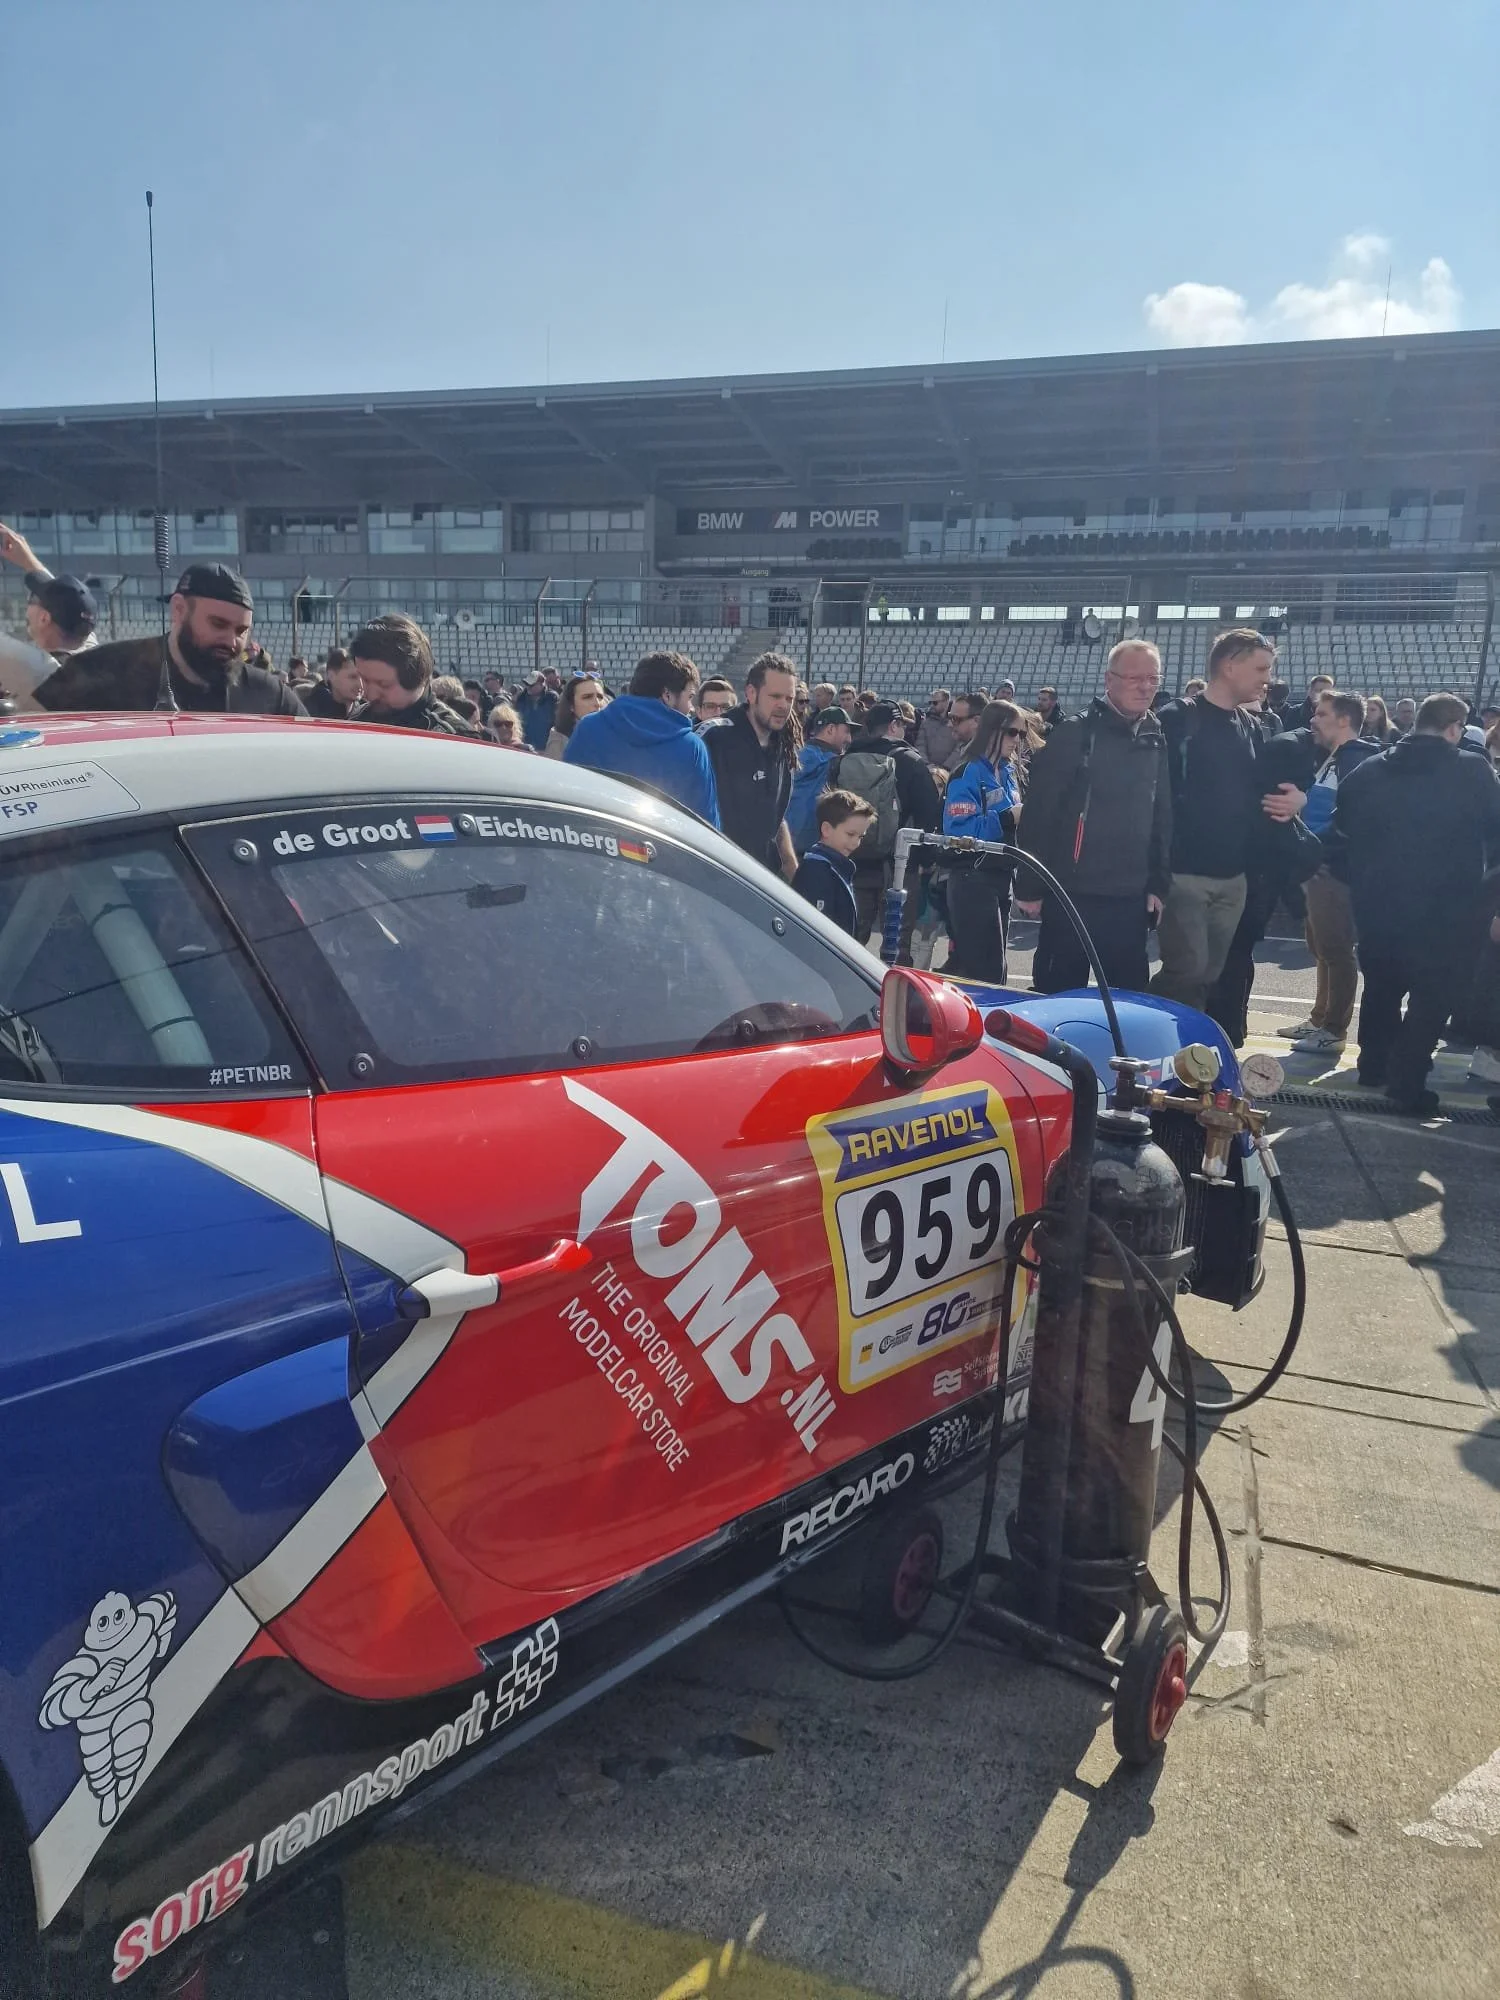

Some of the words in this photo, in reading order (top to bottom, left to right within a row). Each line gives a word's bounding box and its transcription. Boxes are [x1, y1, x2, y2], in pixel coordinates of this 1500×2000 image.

[697, 512, 744, 530] BMW
[773, 511, 797, 529] M
[809, 509, 880, 528] POWER
[1, 801, 38, 819] FSP
[272, 831, 315, 856] de
[323, 818, 412, 849] Groot
[475, 815, 621, 857] Eichenberg
[209, 1063, 293, 1087] #PETNBR
[849, 1112, 985, 1164] RAVENOL
[858, 1161, 1002, 1300] 959
[590, 1262, 635, 1309] THE
[622, 1311, 697, 1407] ORIGINAL
[917, 1291, 971, 1346] 80
[559, 1297, 654, 1423] MODELCAR
[642, 1408, 692, 1473] STORE
[1128, 1320, 1173, 1451] 4
[779, 1451, 916, 1555] RECARO
[112, 1842, 255, 1984] sorg
[255, 1690, 490, 1882] rennsport
